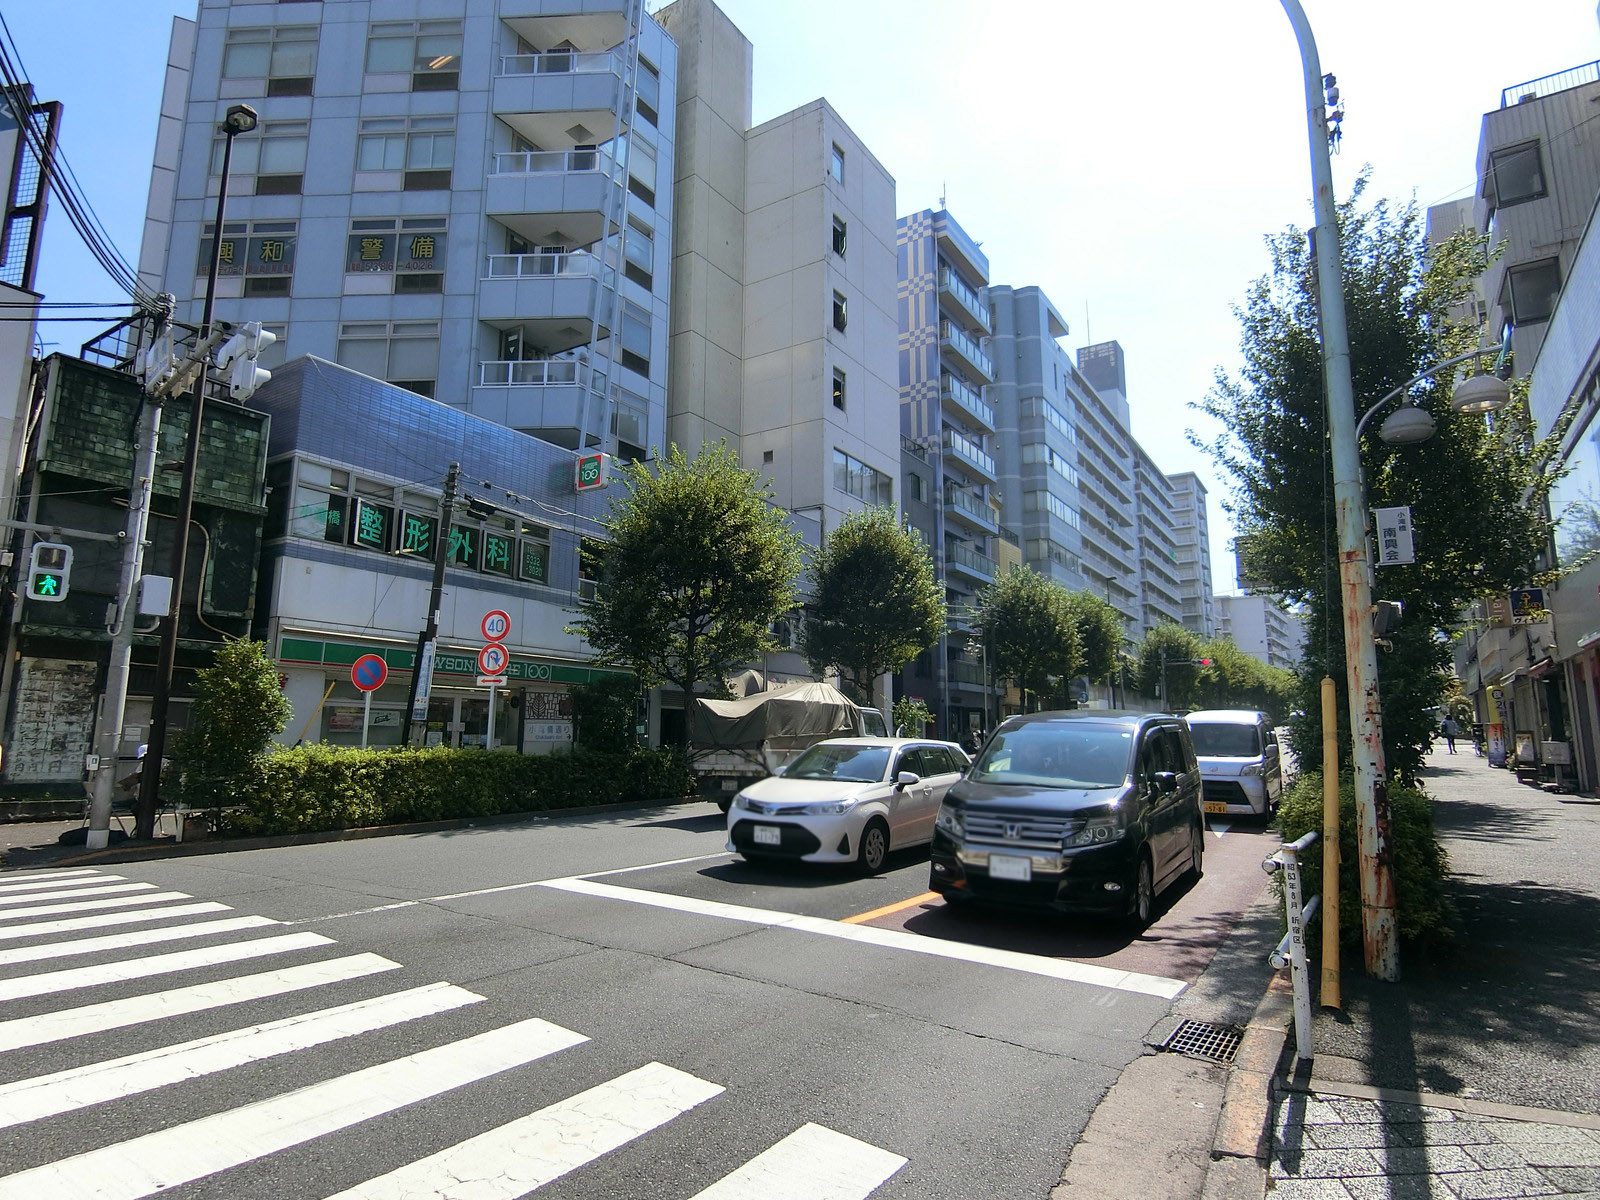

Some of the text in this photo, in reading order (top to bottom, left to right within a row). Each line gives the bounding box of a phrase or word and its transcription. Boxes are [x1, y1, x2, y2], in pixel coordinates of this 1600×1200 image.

[487, 618, 504, 633] 40
[410, 654, 475, 672] LWSON
[524, 664, 550, 680] 100
